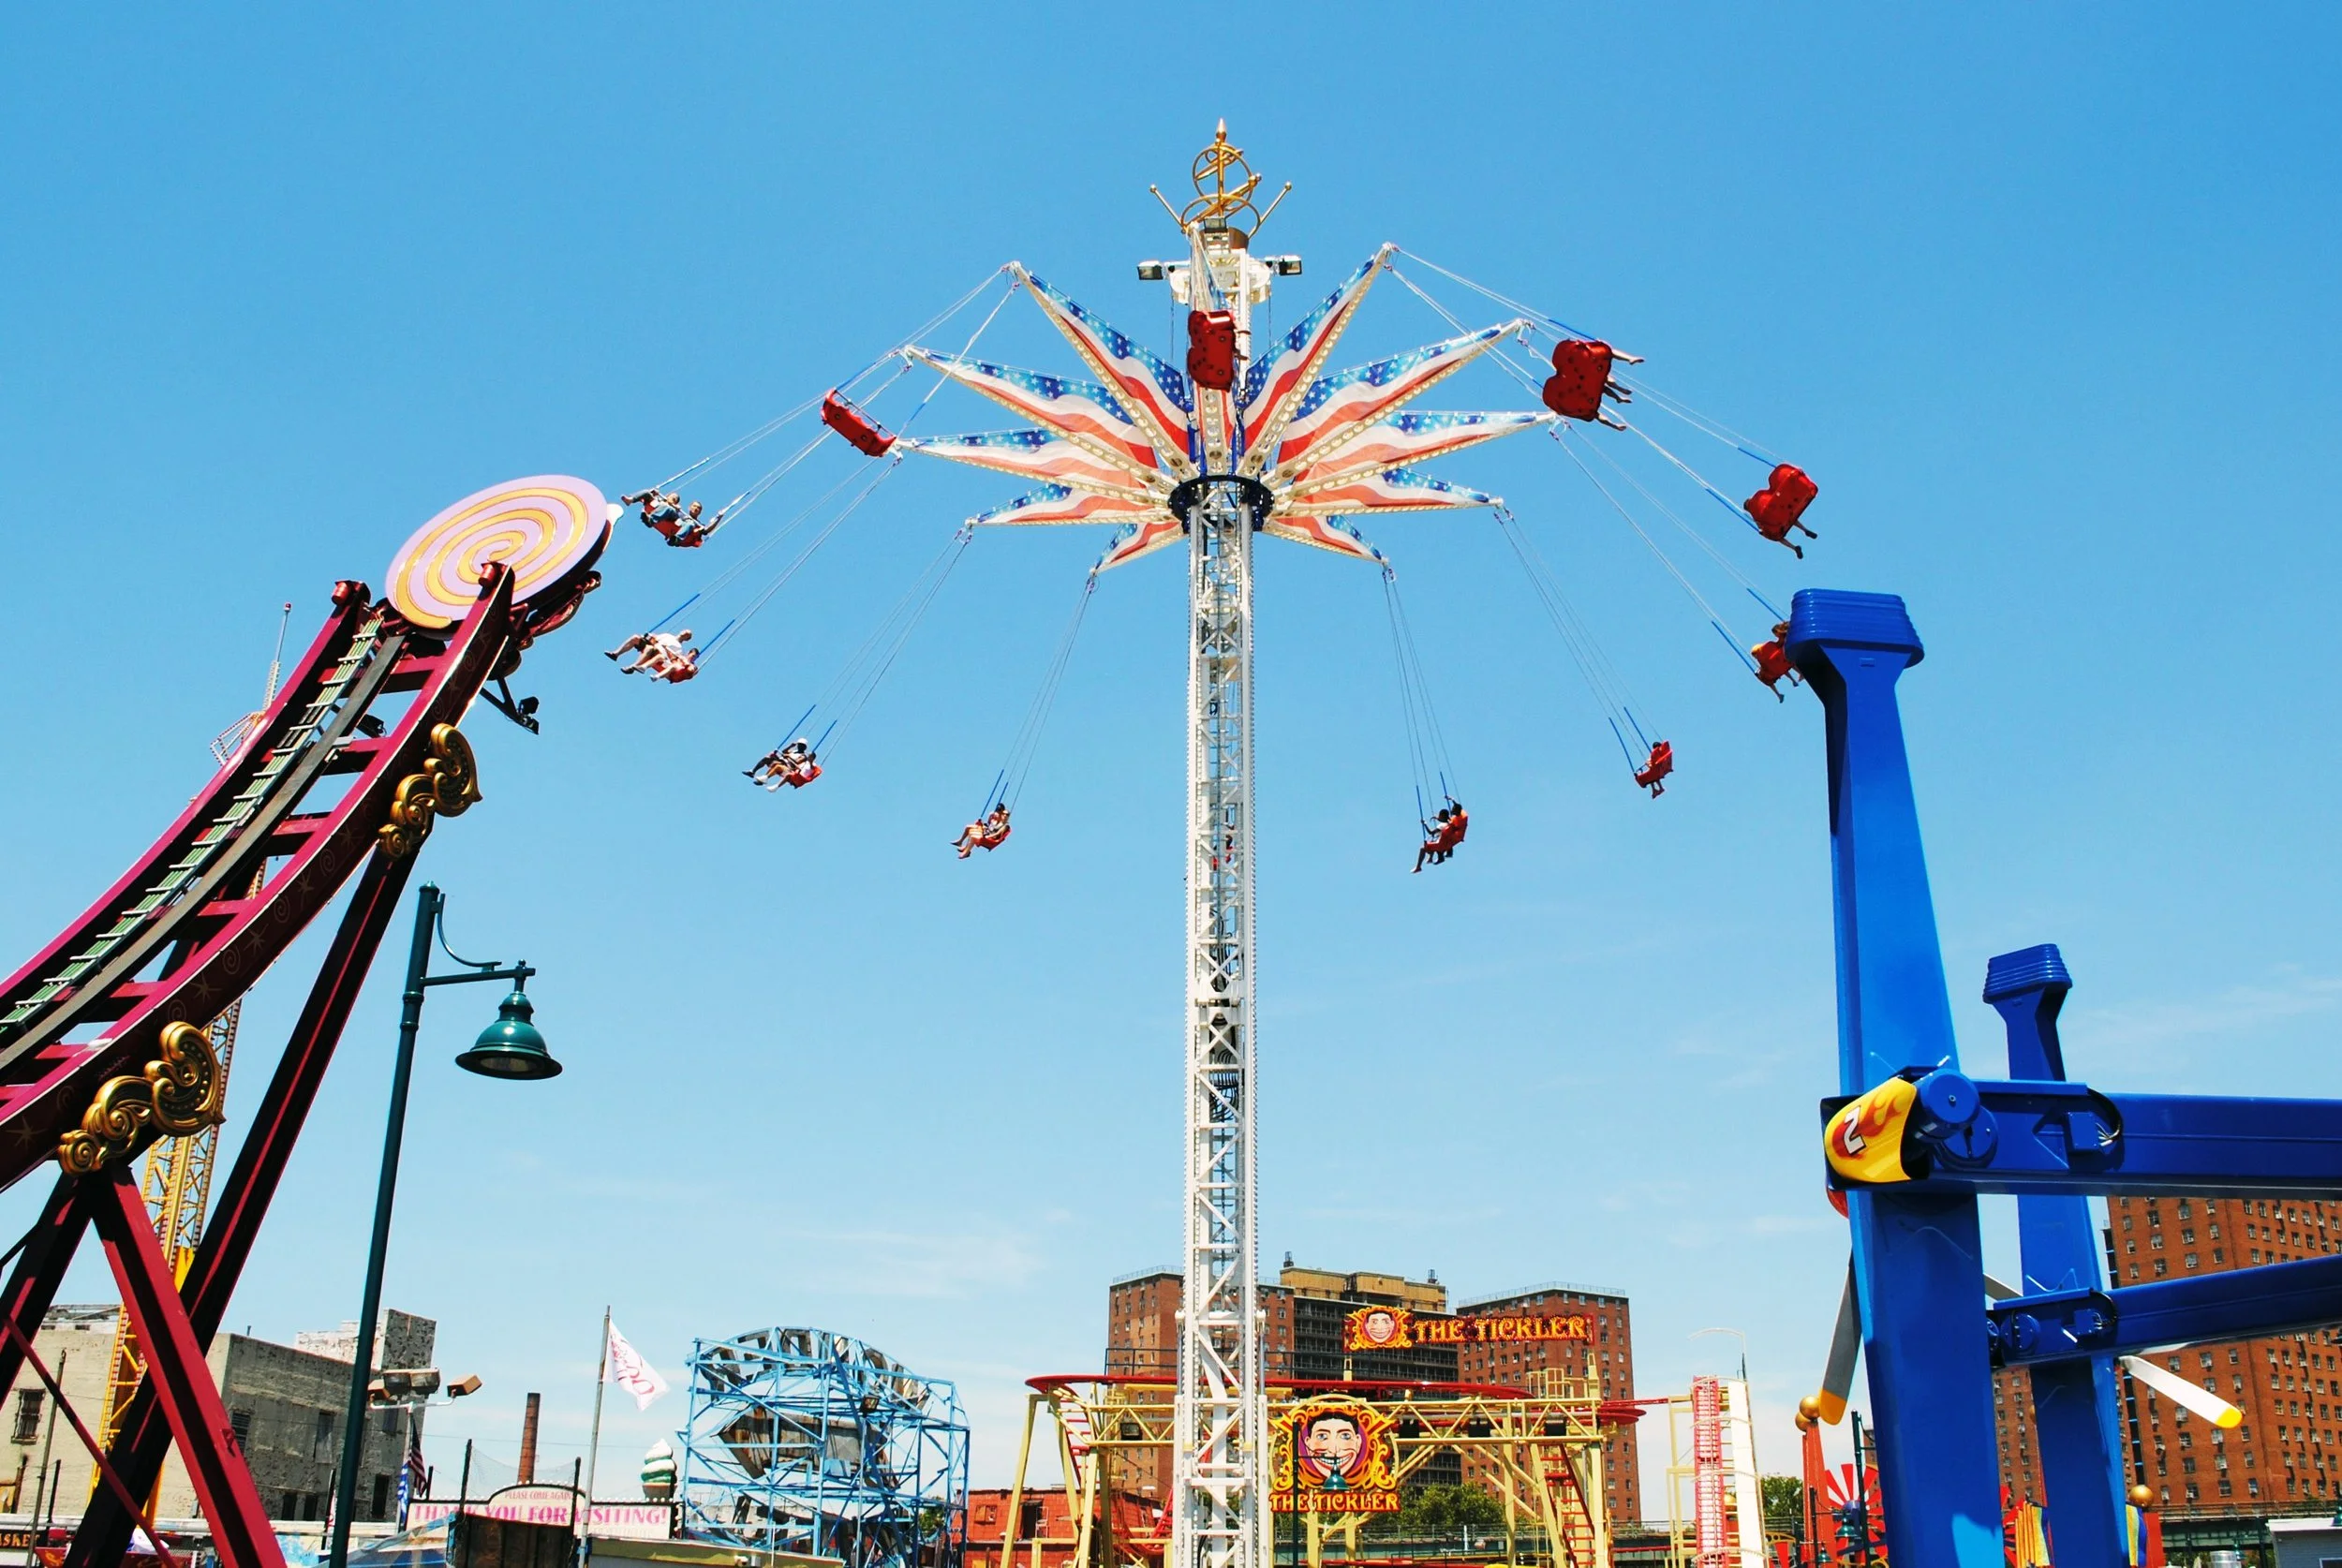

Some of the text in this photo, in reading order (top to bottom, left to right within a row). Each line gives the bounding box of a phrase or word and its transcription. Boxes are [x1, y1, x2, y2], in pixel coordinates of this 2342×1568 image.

[1415, 1315, 1589, 1342] THE TICKLER
[1269, 1492, 1400, 1512] THE TICKLER
[484, 1506, 521, 1522] YOU
[527, 1506, 569, 1523] FOR
